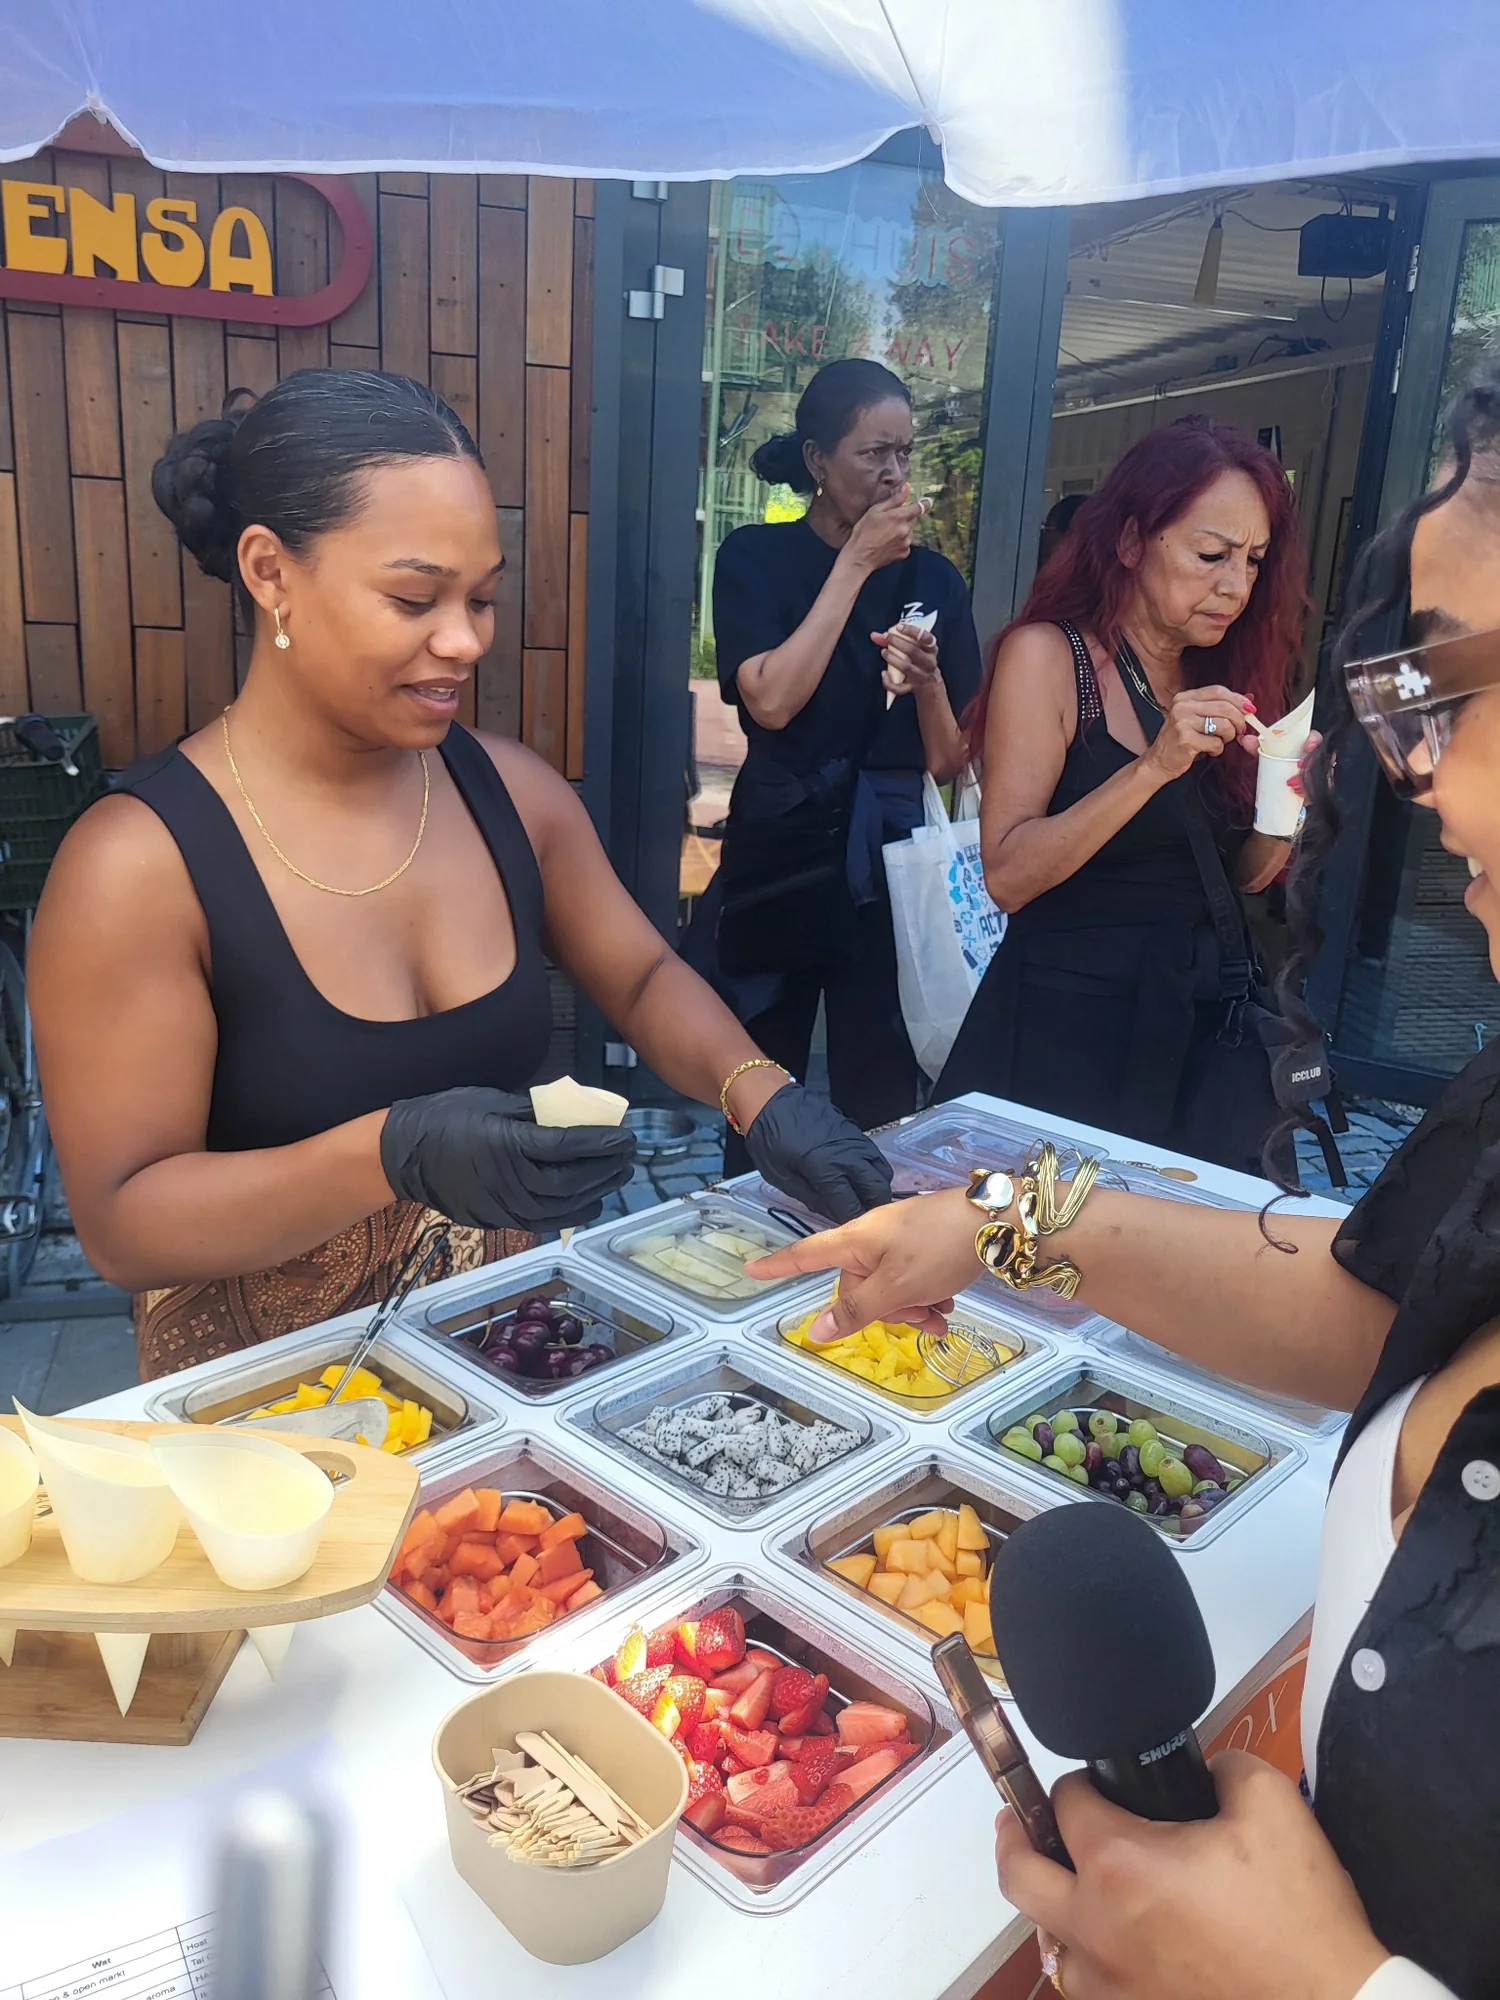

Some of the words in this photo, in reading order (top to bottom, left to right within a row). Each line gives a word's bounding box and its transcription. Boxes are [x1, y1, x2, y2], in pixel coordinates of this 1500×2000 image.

[2, 179, 275, 297] ENSA
[732, 313, 829, 359] TAKE
[1139, 1730, 1187, 1766] SHURE
[91, 1957, 111, 1969] Wat
[73, 1982, 96, 1994] open
[99, 1970, 126, 1985] markt
